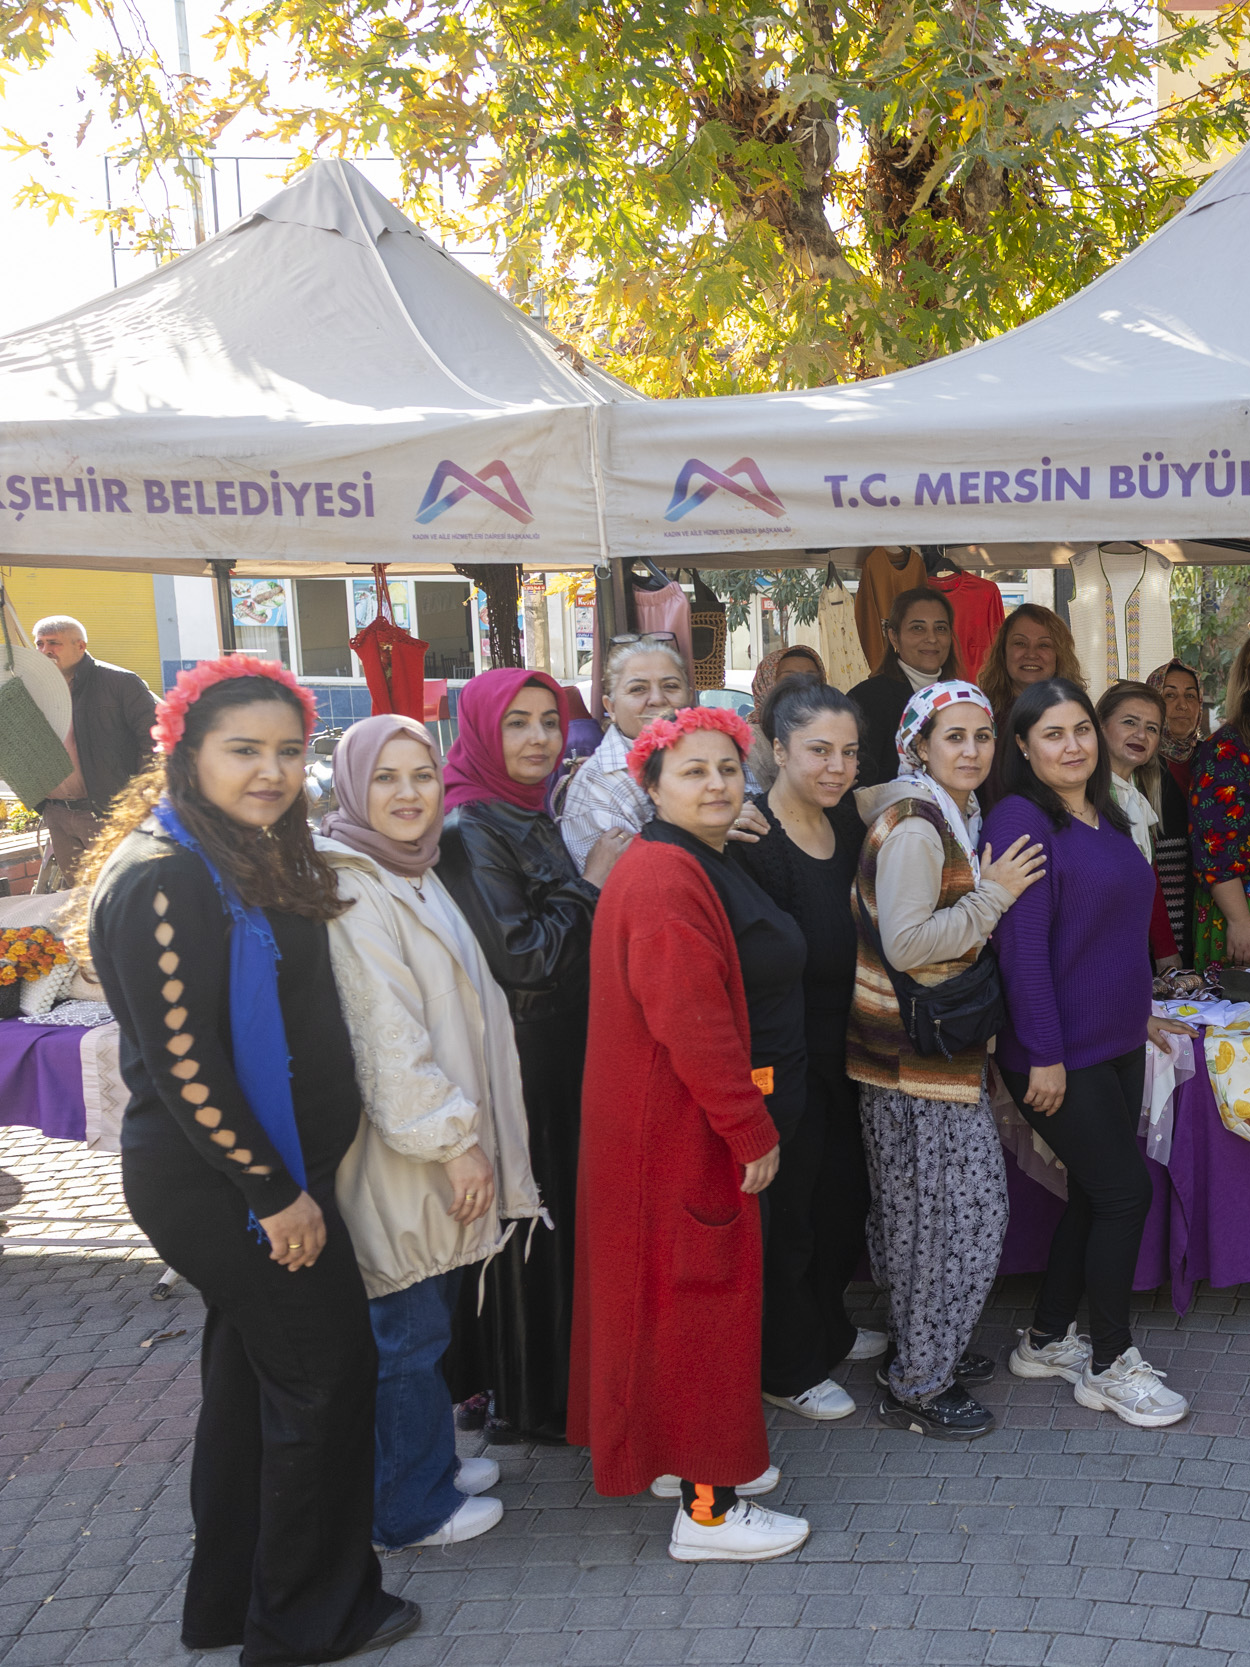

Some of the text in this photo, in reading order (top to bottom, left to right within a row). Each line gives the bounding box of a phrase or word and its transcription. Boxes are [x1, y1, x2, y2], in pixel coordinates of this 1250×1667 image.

[0, 466, 375, 522] ŞEHİR BELEDİYESİ
[824, 473, 901, 508] T.C.
[914, 456, 1091, 506] MERSİN
